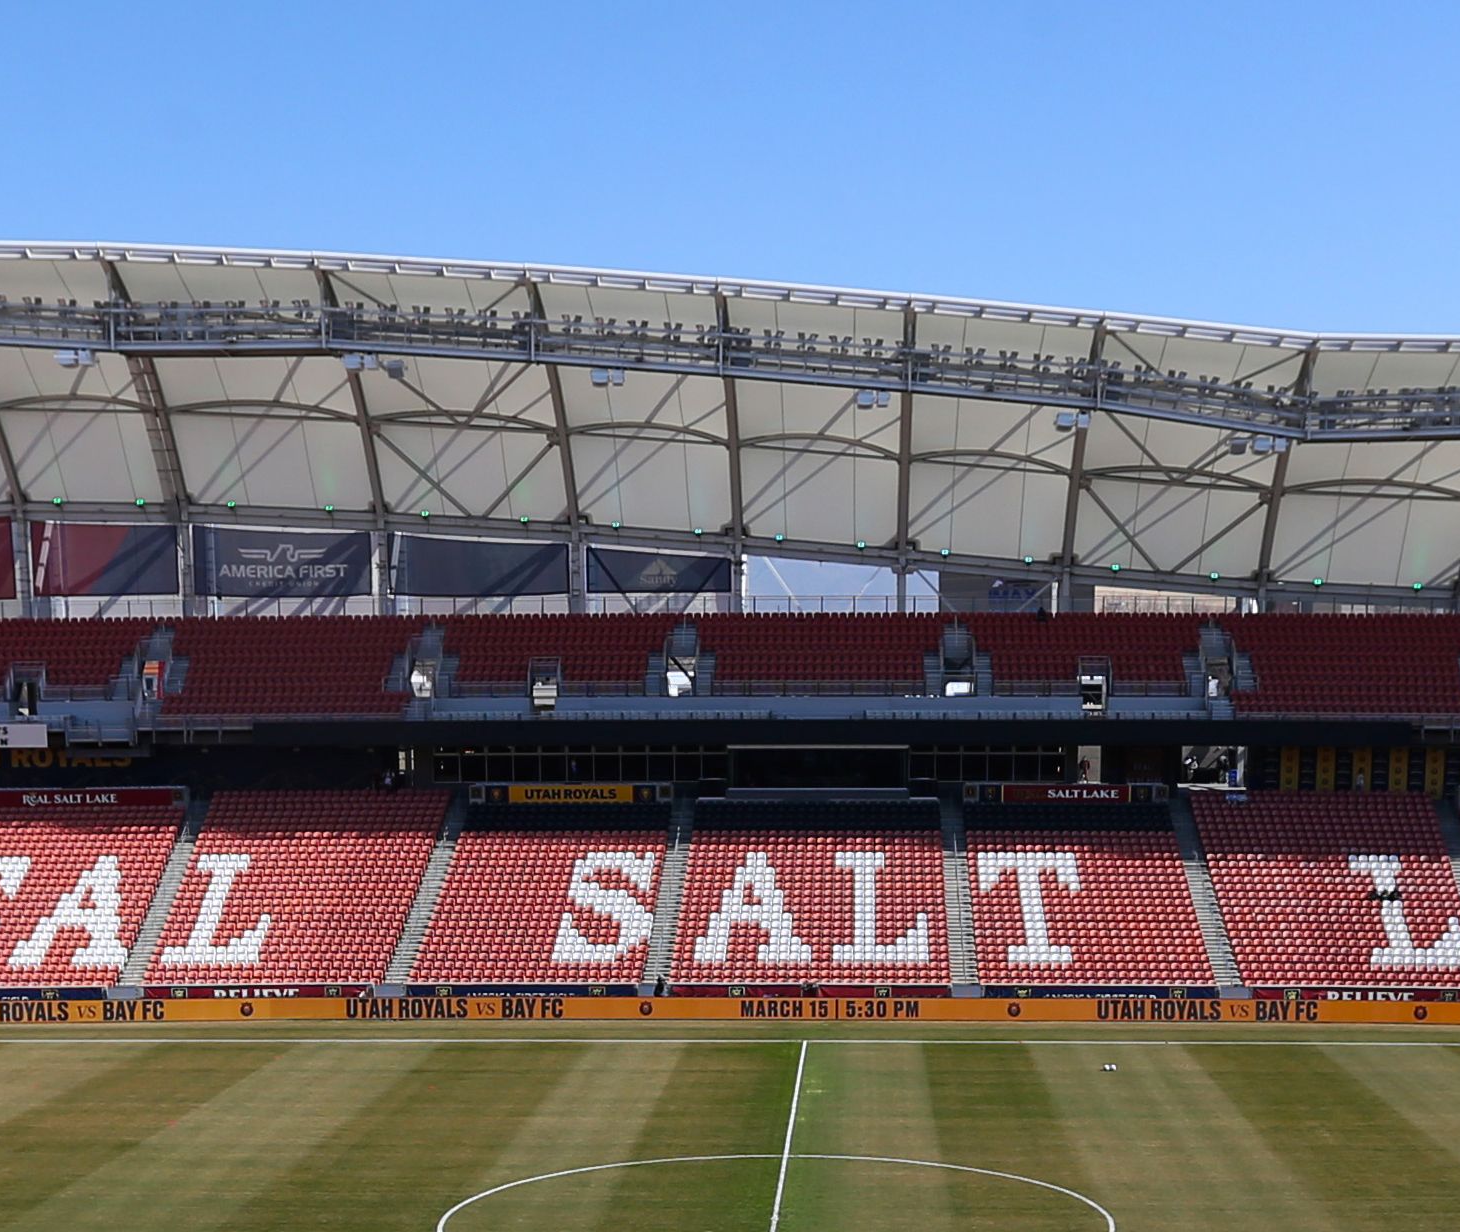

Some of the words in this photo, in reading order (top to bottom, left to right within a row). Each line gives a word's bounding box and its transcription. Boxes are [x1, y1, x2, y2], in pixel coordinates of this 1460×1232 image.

[220, 564, 297, 578] AMERICA
[300, 564, 348, 578] FIRST
[23, 793, 51, 806] REAL
[54, 794, 82, 804] SALT
[86, 793, 118, 804] LAKE
[525, 789, 560, 799] UTAH
[564, 789, 617, 799] ROYALS
[1047, 789, 1082, 798] SALT
[1083, 789, 1119, 798] LAKE
[551, 851, 1082, 968] SALT
[0, 1001, 69, 1022] ROYALS
[77, 1005, 97, 1018] VS
[103, 1001, 136, 1021] BAY
[142, 1001, 165, 1020] FC
[346, 999, 391, 1018] UTAH
[400, 999, 468, 1018] ROYALS
[476, 1002, 496, 1016] VS
[502, 998, 536, 1018] BAY
[541, 998, 563, 1018] FC
[741, 1000, 803, 1018] MARCH
[809, 1000, 828, 1017] 15
[846, 1000, 887, 1017] 5:30
[894, 1000, 920, 1017] PM
[1097, 1000, 1141, 1020] UTAH
[1151, 1001, 1221, 1020] ROYALS
[1230, 1004, 1249, 1018] VS
[1255, 1001, 1290, 1021] BAY
[1295, 1001, 1318, 1021] FC
